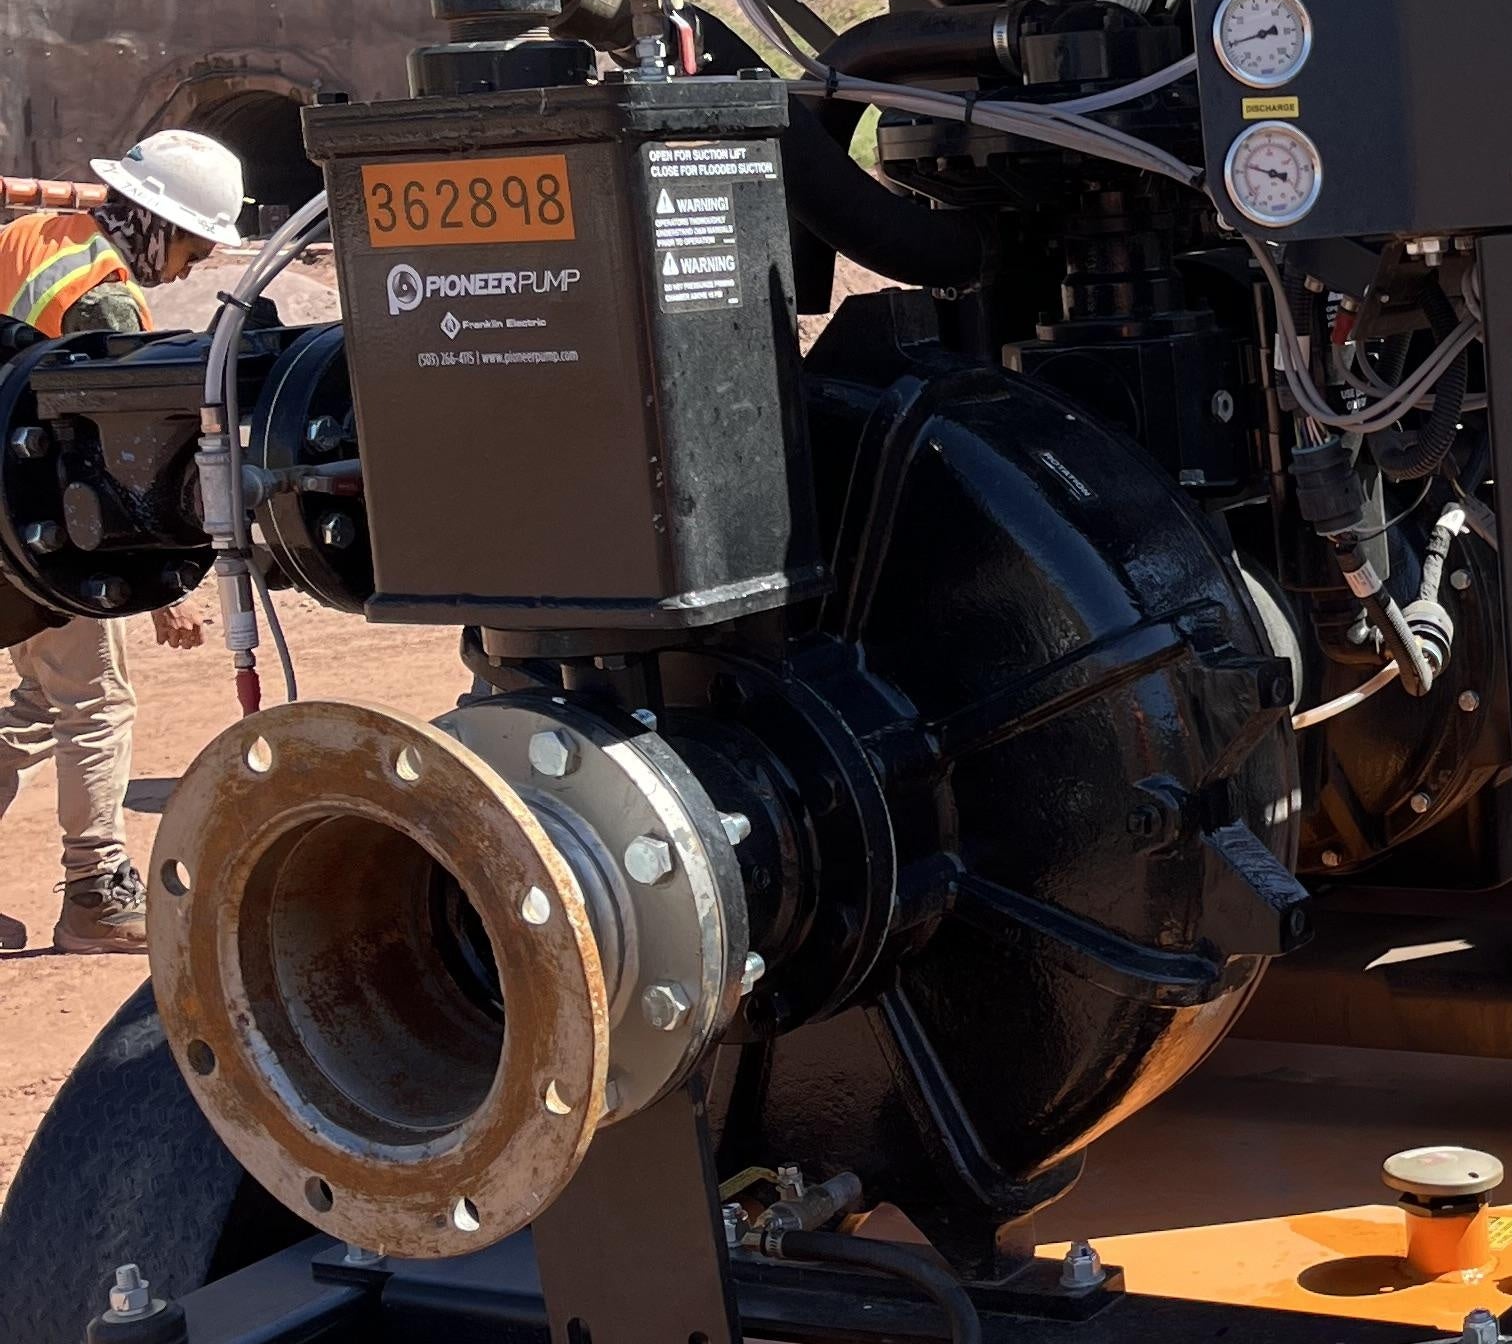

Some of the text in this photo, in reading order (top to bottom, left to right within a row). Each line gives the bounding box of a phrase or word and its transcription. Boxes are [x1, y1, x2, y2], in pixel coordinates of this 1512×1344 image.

[1245, 103, 1295, 113] DISCHARGE
[649, 148, 747, 162] OPEN FOR SUCTION LIFT
[650, 162, 773, 177] CLOSE FOR FLOODED SUCTION
[371, 174, 565, 233] 362898
[676, 197, 729, 212] WARNING!
[680, 255, 736, 274] WARNING
[425, 269, 581, 297] PIONEERPUMP
[462, 317, 547, 329] Franklin Electric
[418, 352, 439, 367] (503)
[481, 349, 579, 366] www.pioneerpump.com
